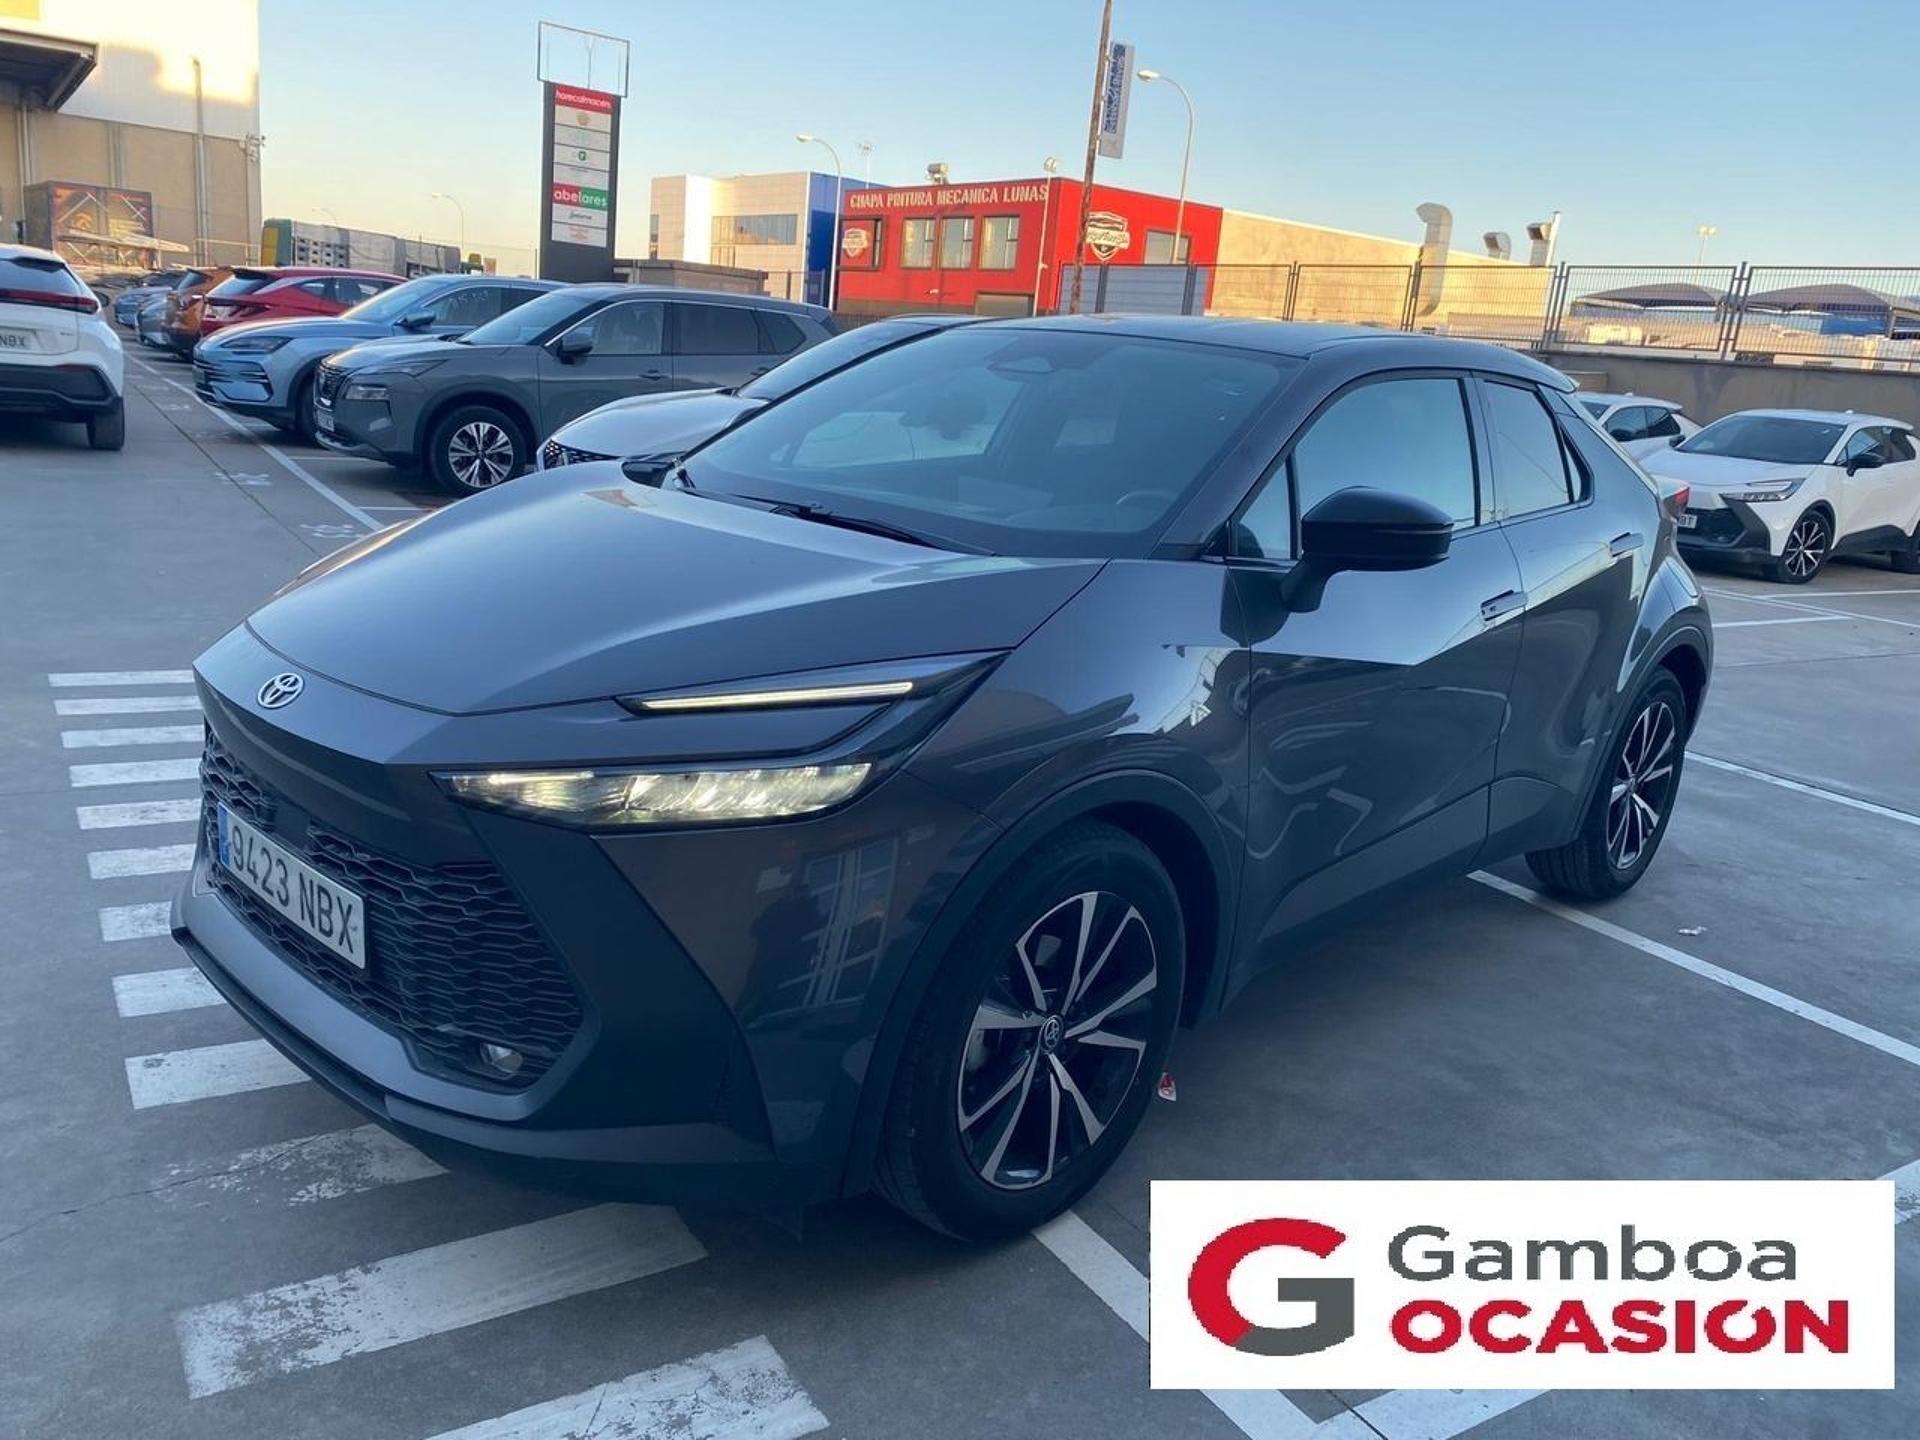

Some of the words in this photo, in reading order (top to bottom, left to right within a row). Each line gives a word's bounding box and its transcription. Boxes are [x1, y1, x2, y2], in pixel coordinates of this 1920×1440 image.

[553, 188, 607, 207] abelares
[850, 193, 883, 208] CHAPA
[887, 191, 933, 207] PINTURA
[936, 187, 998, 205] MECANICA
[1003, 184, 1048, 202] LUNAS
[232, 825, 290, 907] 9423
[299, 872, 353, 954] NBX
